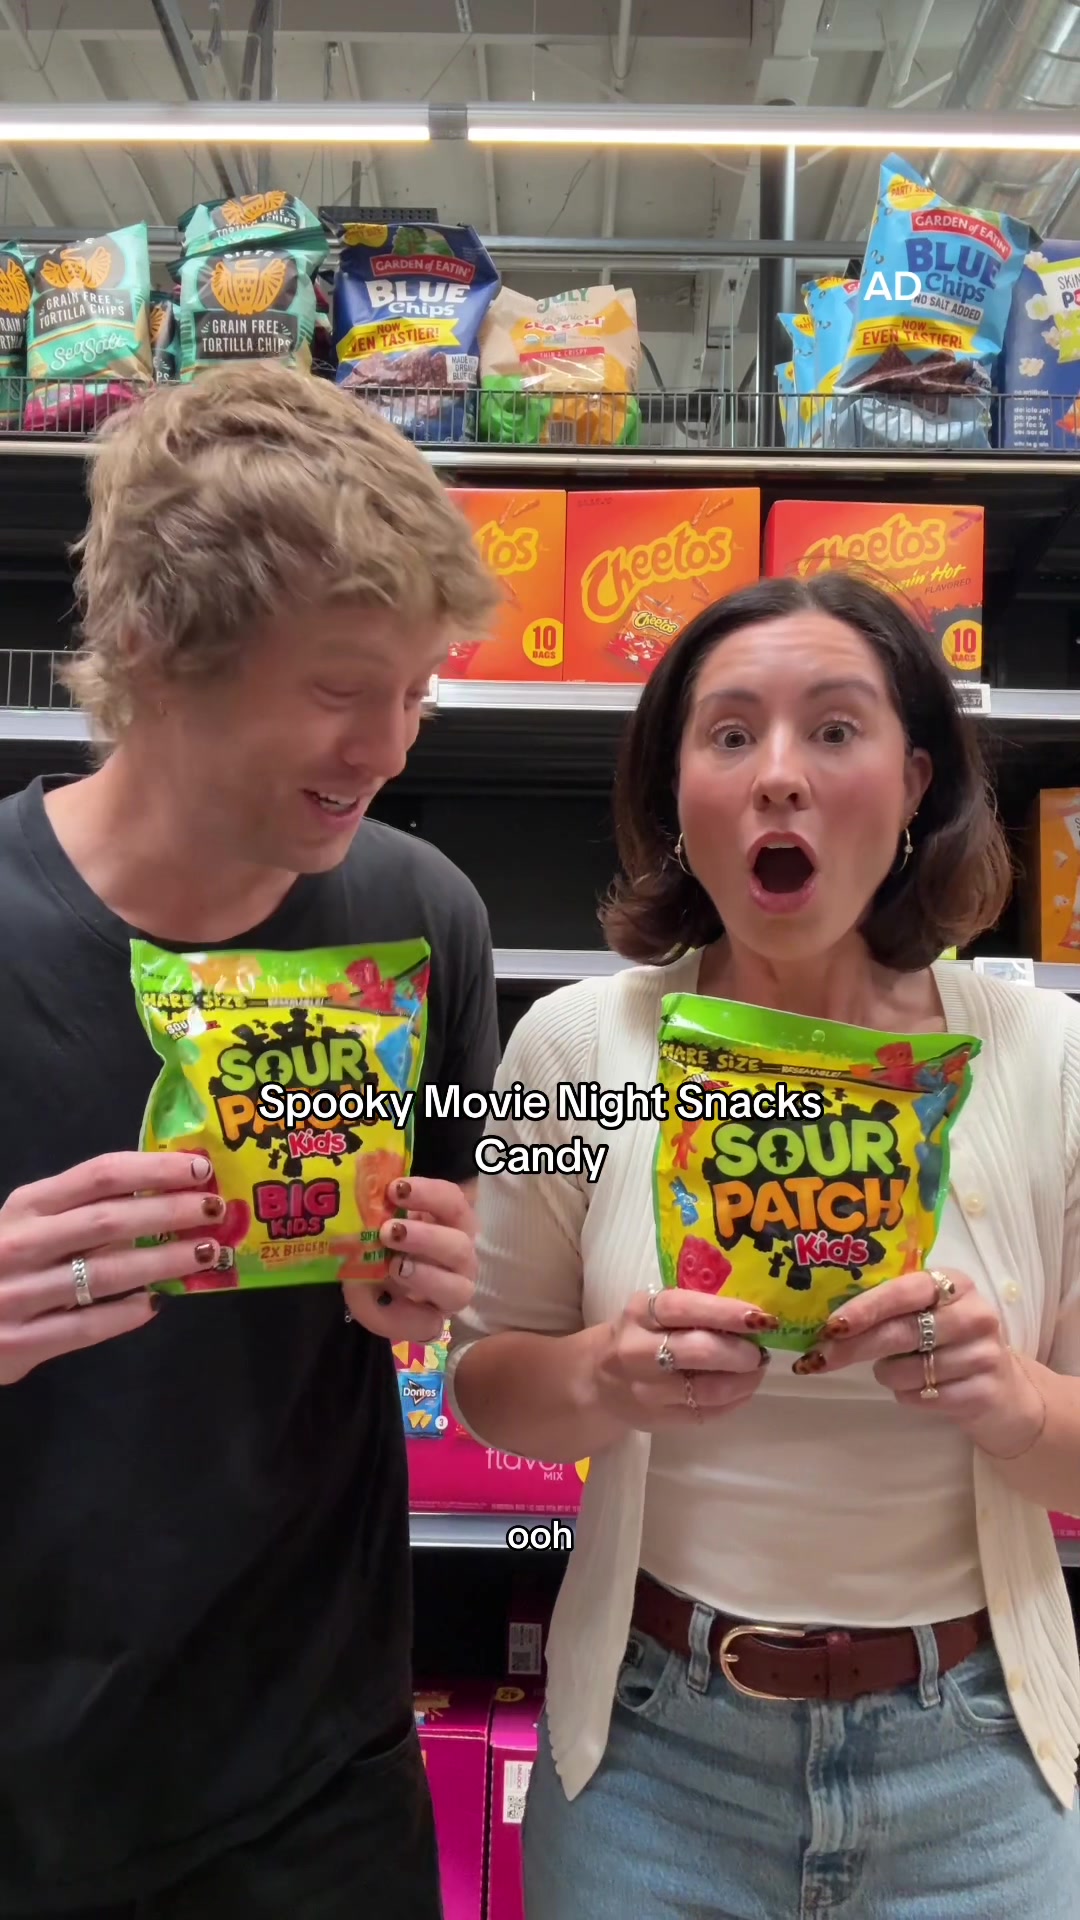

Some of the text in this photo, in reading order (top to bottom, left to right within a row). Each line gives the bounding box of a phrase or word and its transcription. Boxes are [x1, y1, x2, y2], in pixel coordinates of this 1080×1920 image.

[915, 215, 968, 230] GARDEN
[969, 224, 980, 235] of
[375, 259, 423, 271] GARDEN
[425, 258, 434, 272] of
[905, 237, 1002, 290] BLUE
[365, 279, 471, 308] BLUE
[925, 272, 986, 304] Chips
[46, 291, 111, 310] GRAIN FREE
[388, 302, 454, 318] Chips
[914, 293, 981, 321] NO SALT ADDED
[0, 317, 21, 332] RAIN
[39, 304, 86, 329] TORTILLA
[90, 304, 125, 316] CHIPS
[212, 319, 279, 334] GRAIN FREE
[902, 319, 927, 331] NOW
[376, 322, 401, 335] NOW
[862, 329, 963, 348] EVEN TASTIER!
[202, 337, 292, 353] TORTILLA CHIPS
[351, 327, 440, 353] VEN TASTIER!
[51, 342, 85, 371] Sea
[564, 348, 588, 356] CRISPY
[582, 522, 732, 623] Cheetos
[930, 562, 967, 582] Hot
[924, 577, 972, 595] FLAVORED
[632, 610, 680, 636] Cheetos
[532, 625, 557, 651] 10
[952, 627, 977, 654] 10
[532, 651, 557, 659] BAGS
[952, 654, 976, 662] BAGS
[166, 1018, 189, 1035] SOU
[221, 1038, 364, 1092] SOUR
[287, 1128, 347, 1159] Kids
[715, 1119, 896, 1177] SOUR
[255, 1181, 338, 1221] BIG
[712, 1176, 906, 1238] PATCH
[270, 1217, 321, 1237] KIDS
[260, 1241, 329, 1260] 2X BIGGER!
[793, 1231, 870, 1265] Kids
[403, 1387, 436, 1397] Doritos
[439, 1418, 444, 1427] 3
[543, 1471, 564, 1480] MIX
